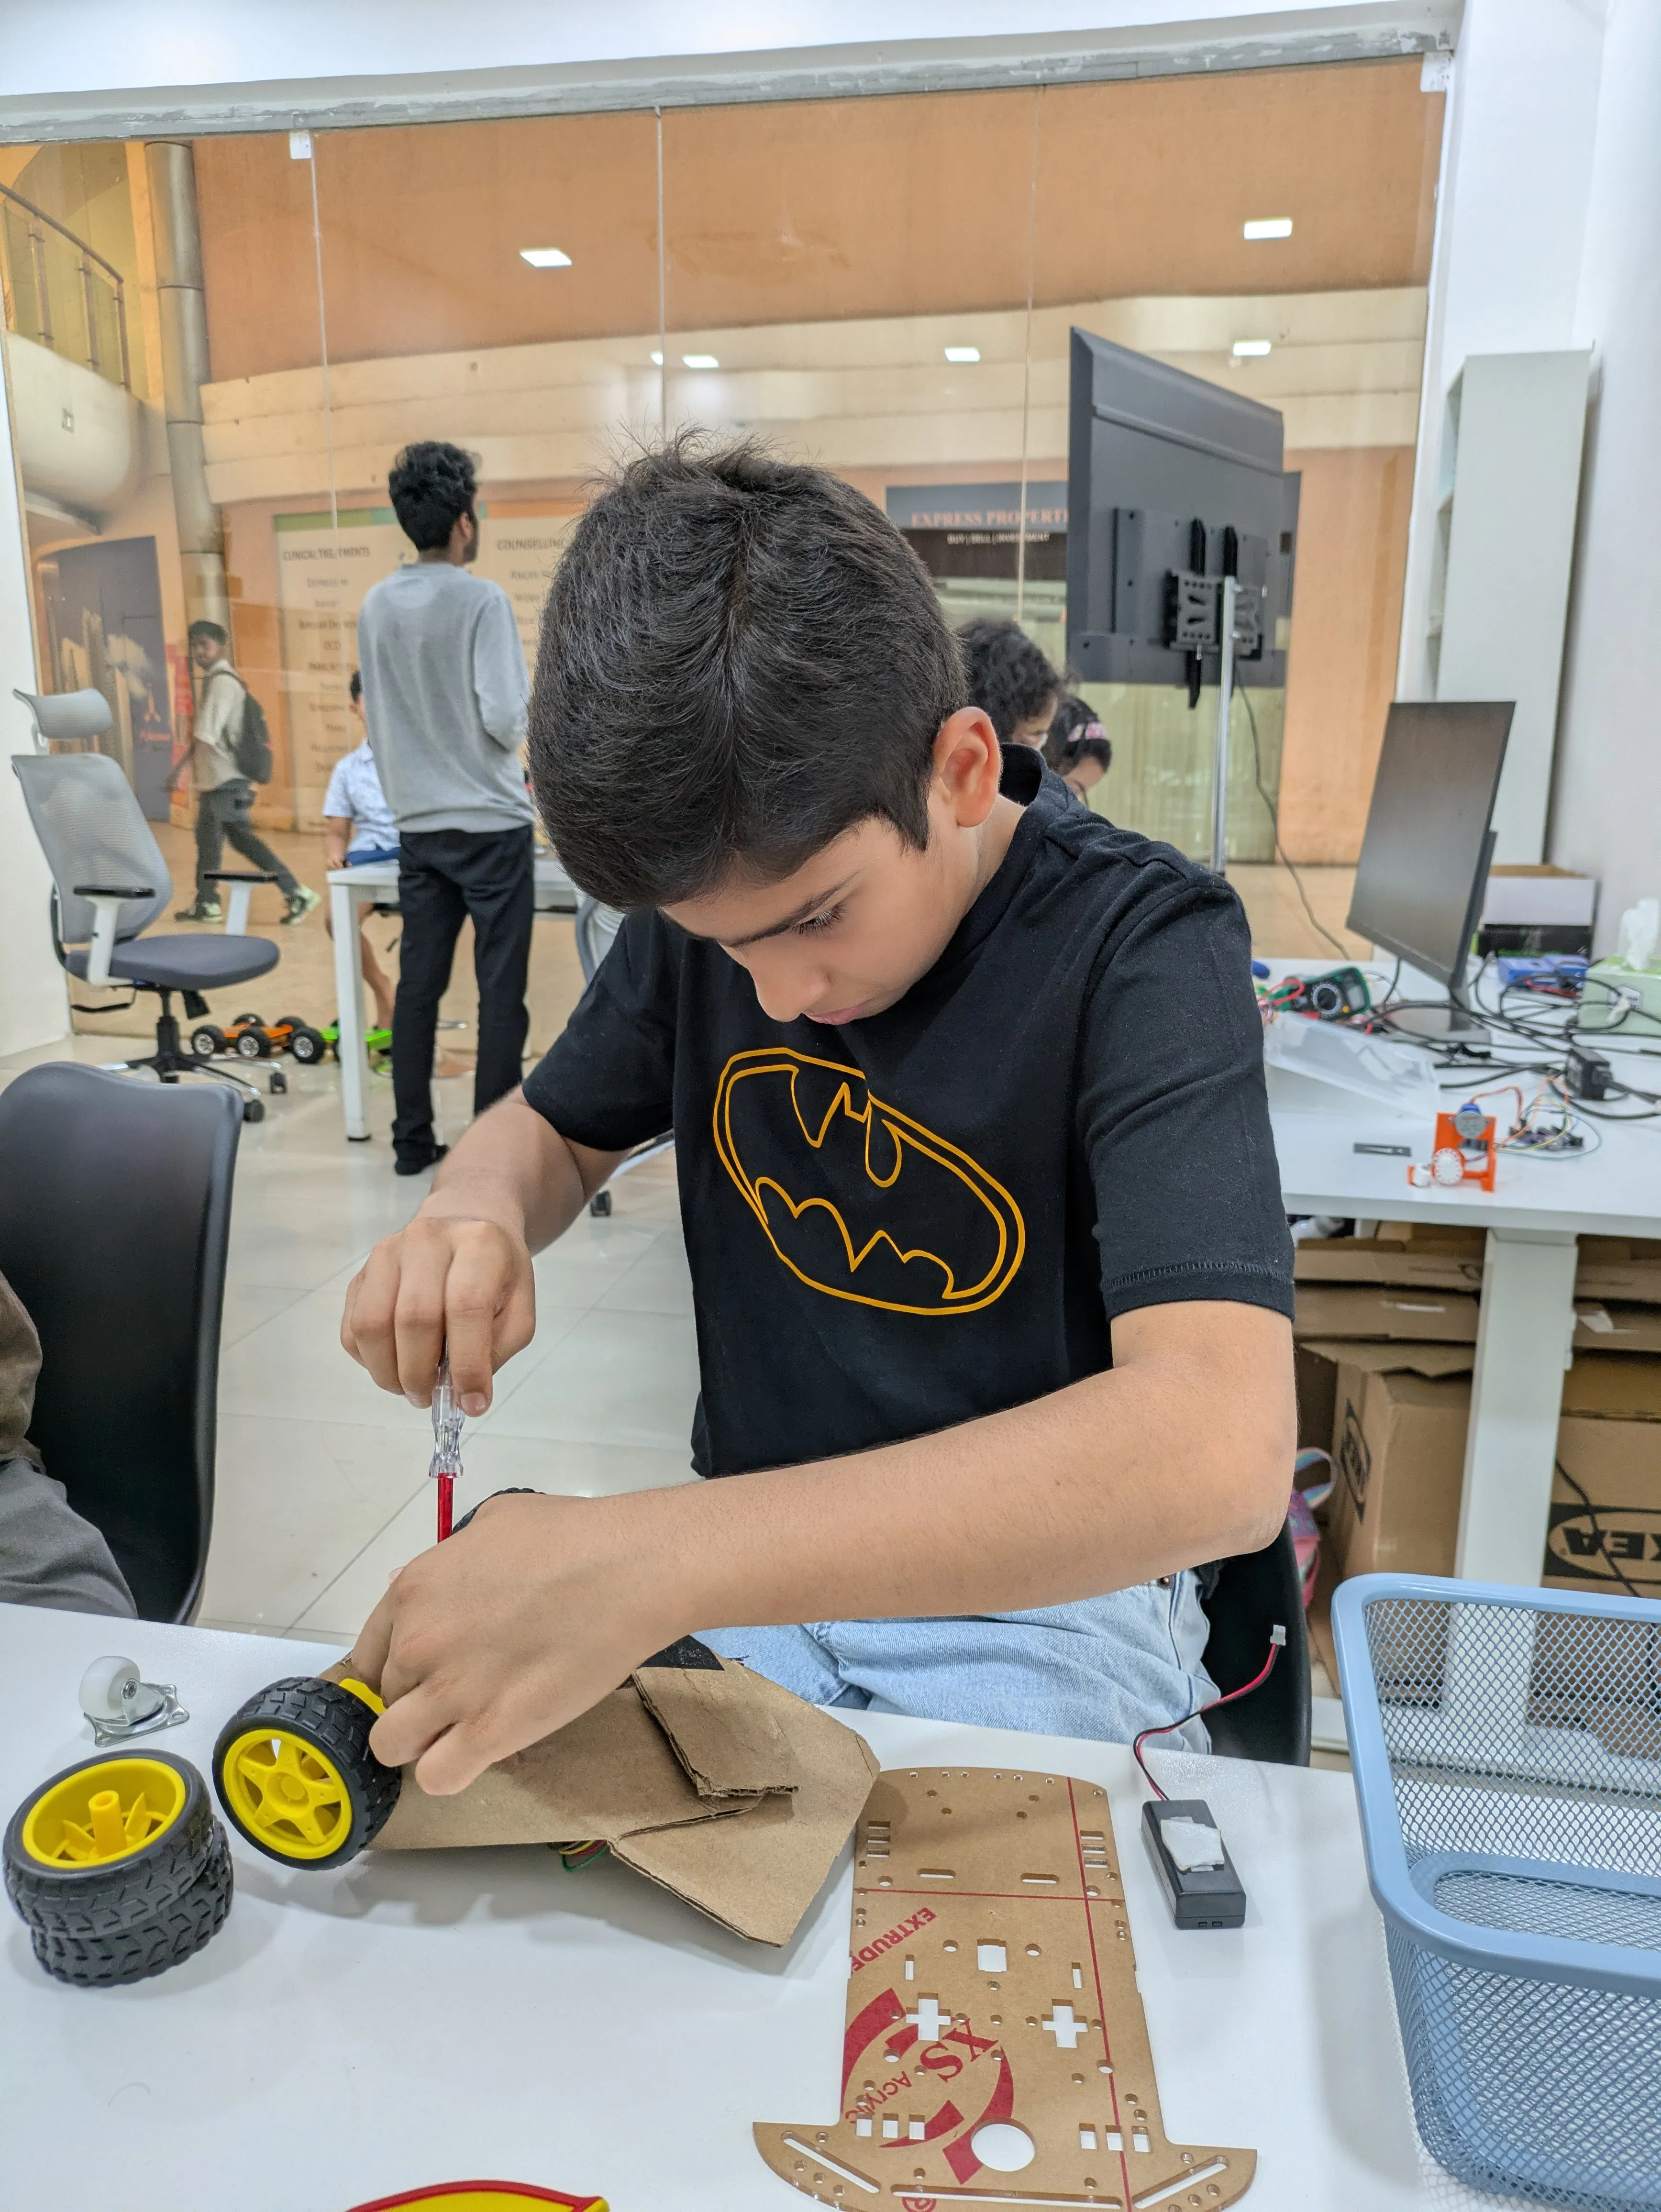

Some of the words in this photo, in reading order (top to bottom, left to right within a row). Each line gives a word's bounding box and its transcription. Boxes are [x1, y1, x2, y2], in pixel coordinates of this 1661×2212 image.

[911, 512, 983, 527] EXPRESS
[317, 547, 371, 559] TRETMENTS
[920, 2018, 998, 2083] XS
